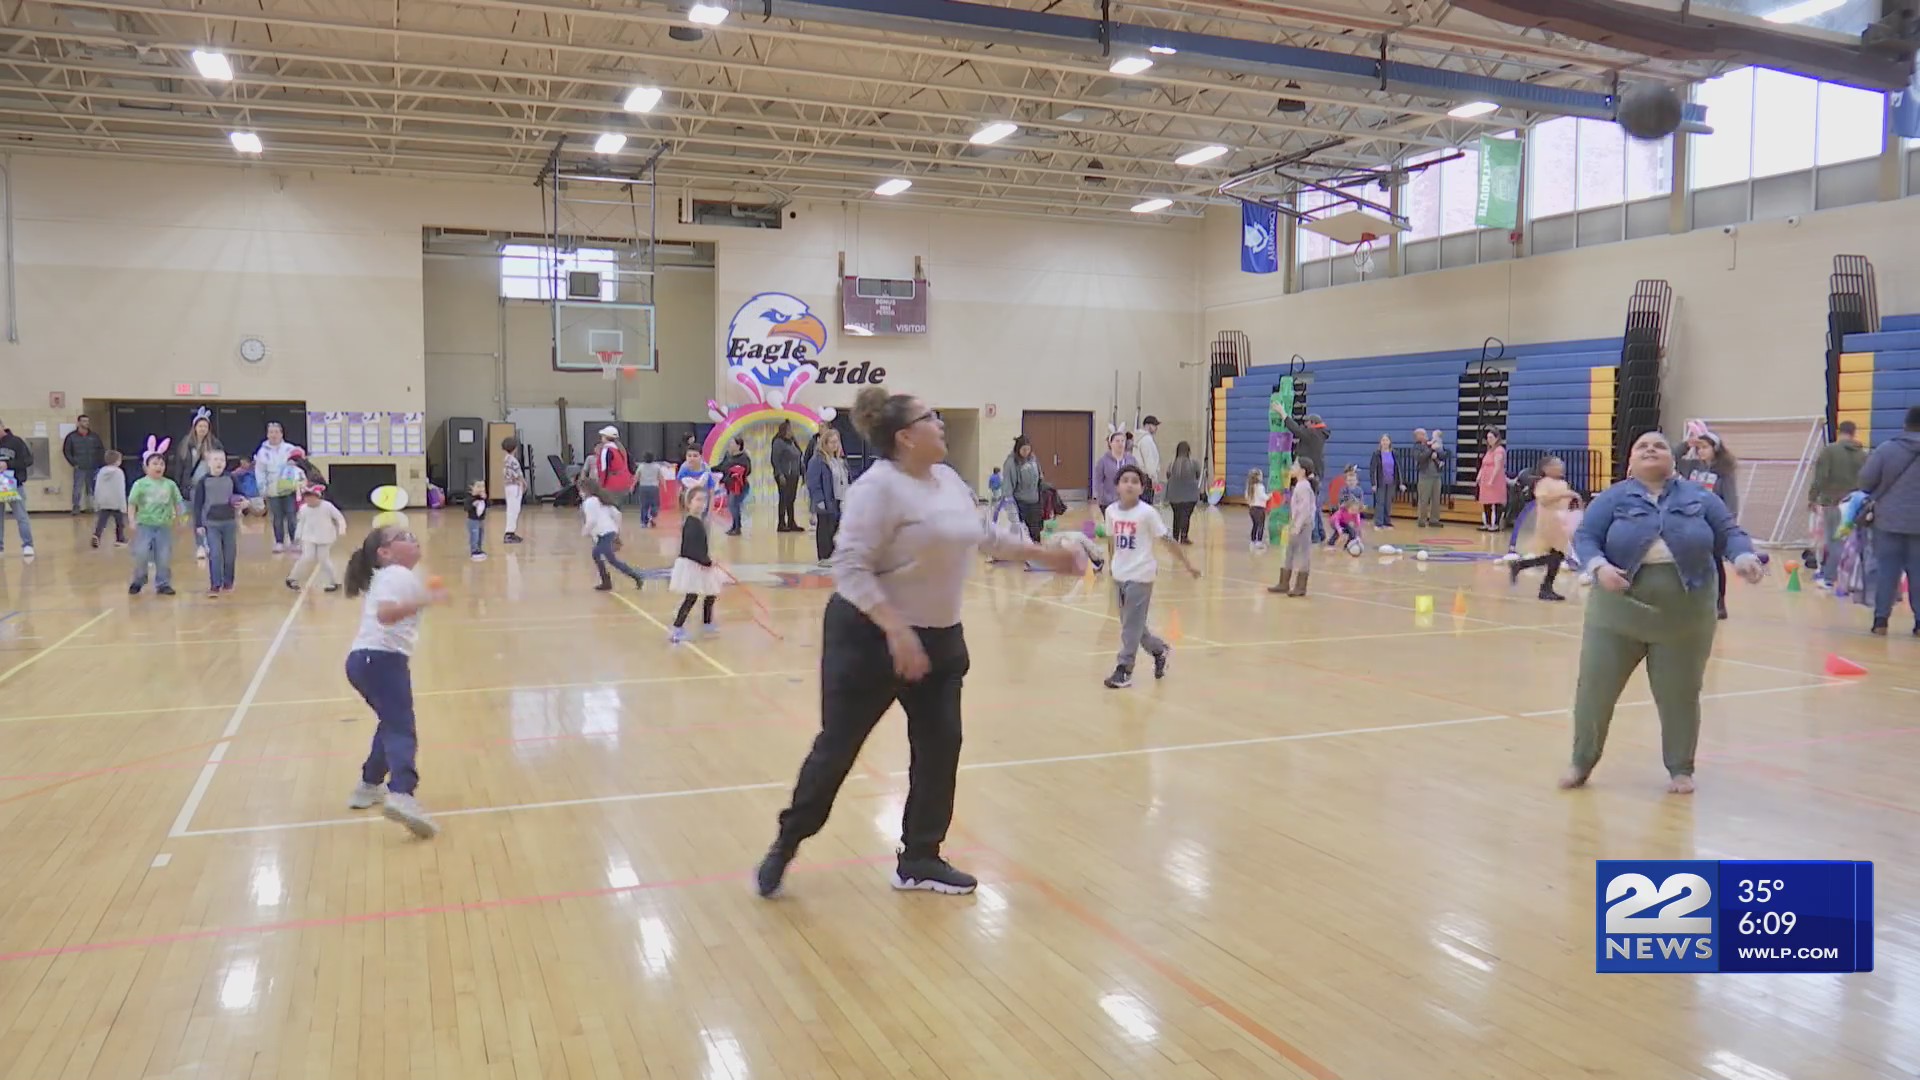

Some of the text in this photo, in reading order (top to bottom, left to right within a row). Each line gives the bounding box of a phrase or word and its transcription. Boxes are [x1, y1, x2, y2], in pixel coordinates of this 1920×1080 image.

[896, 324, 926, 333] VISITOR
[726, 338, 807, 364] Eagle
[1114, 521, 1137, 534] ET'S
